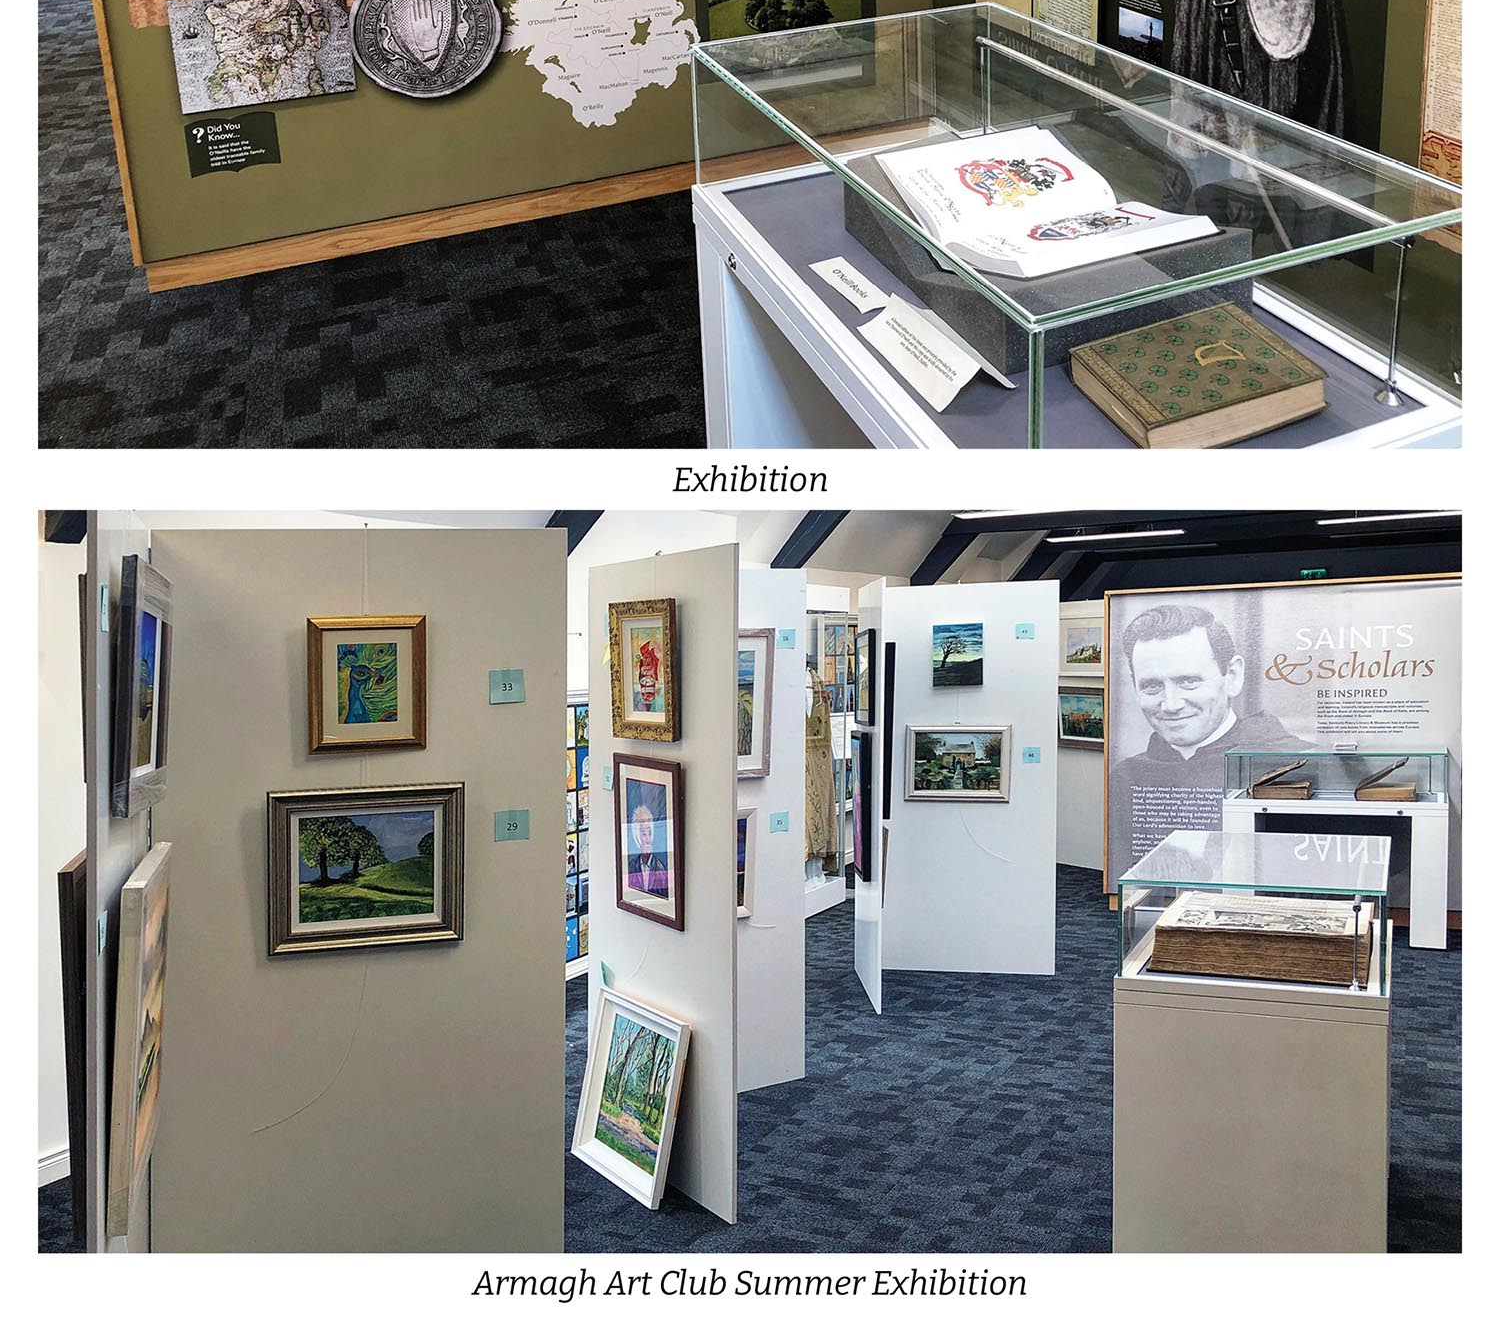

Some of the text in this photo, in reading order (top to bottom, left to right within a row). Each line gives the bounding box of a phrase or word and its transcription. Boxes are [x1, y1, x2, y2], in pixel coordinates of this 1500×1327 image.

[558, 72, 581, 81] Maguire
[207, 123, 241, 134] Did You
[1295, 624, 1415, 651] SAINTS
[1264, 653, 1313, 686] &
[501, 682, 513, 692] 33
[1317, 688, 1388, 698] BE INSPIRED
[506, 822, 518, 832] 29
